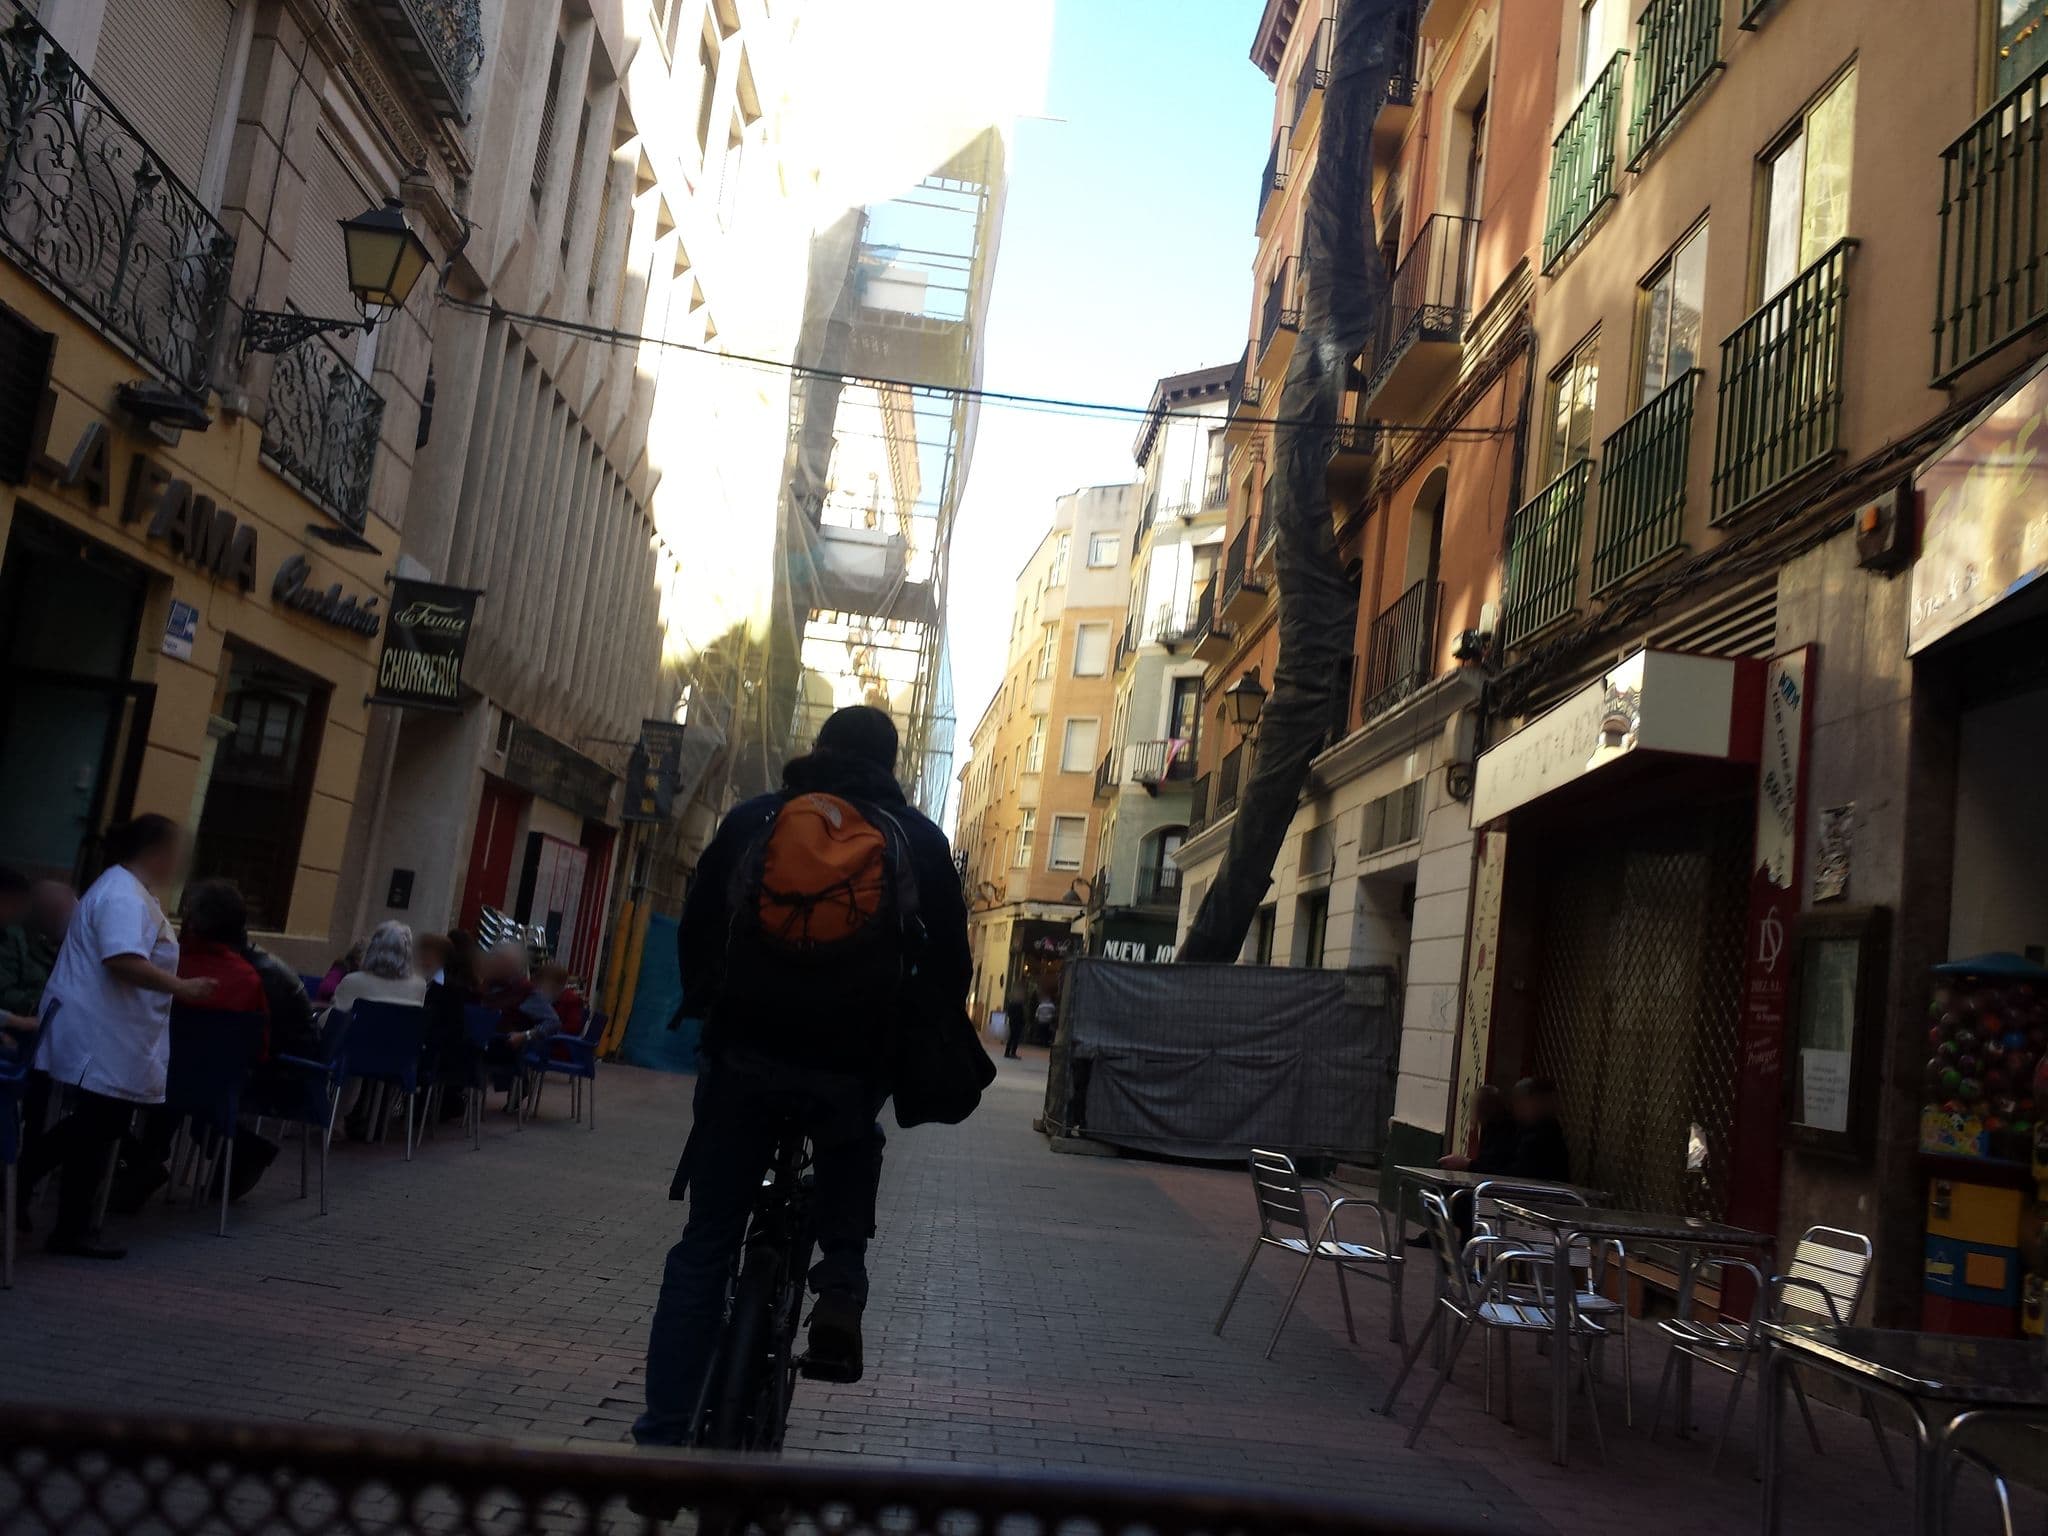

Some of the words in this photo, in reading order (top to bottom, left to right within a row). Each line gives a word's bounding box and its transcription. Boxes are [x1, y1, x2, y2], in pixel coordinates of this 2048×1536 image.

[120, 454, 258, 596] FAMA
[409, 600, 467, 632] Fama
[380, 647, 460, 698] CHURRERÍA
[1102, 939, 1146, 963] NUEVA
